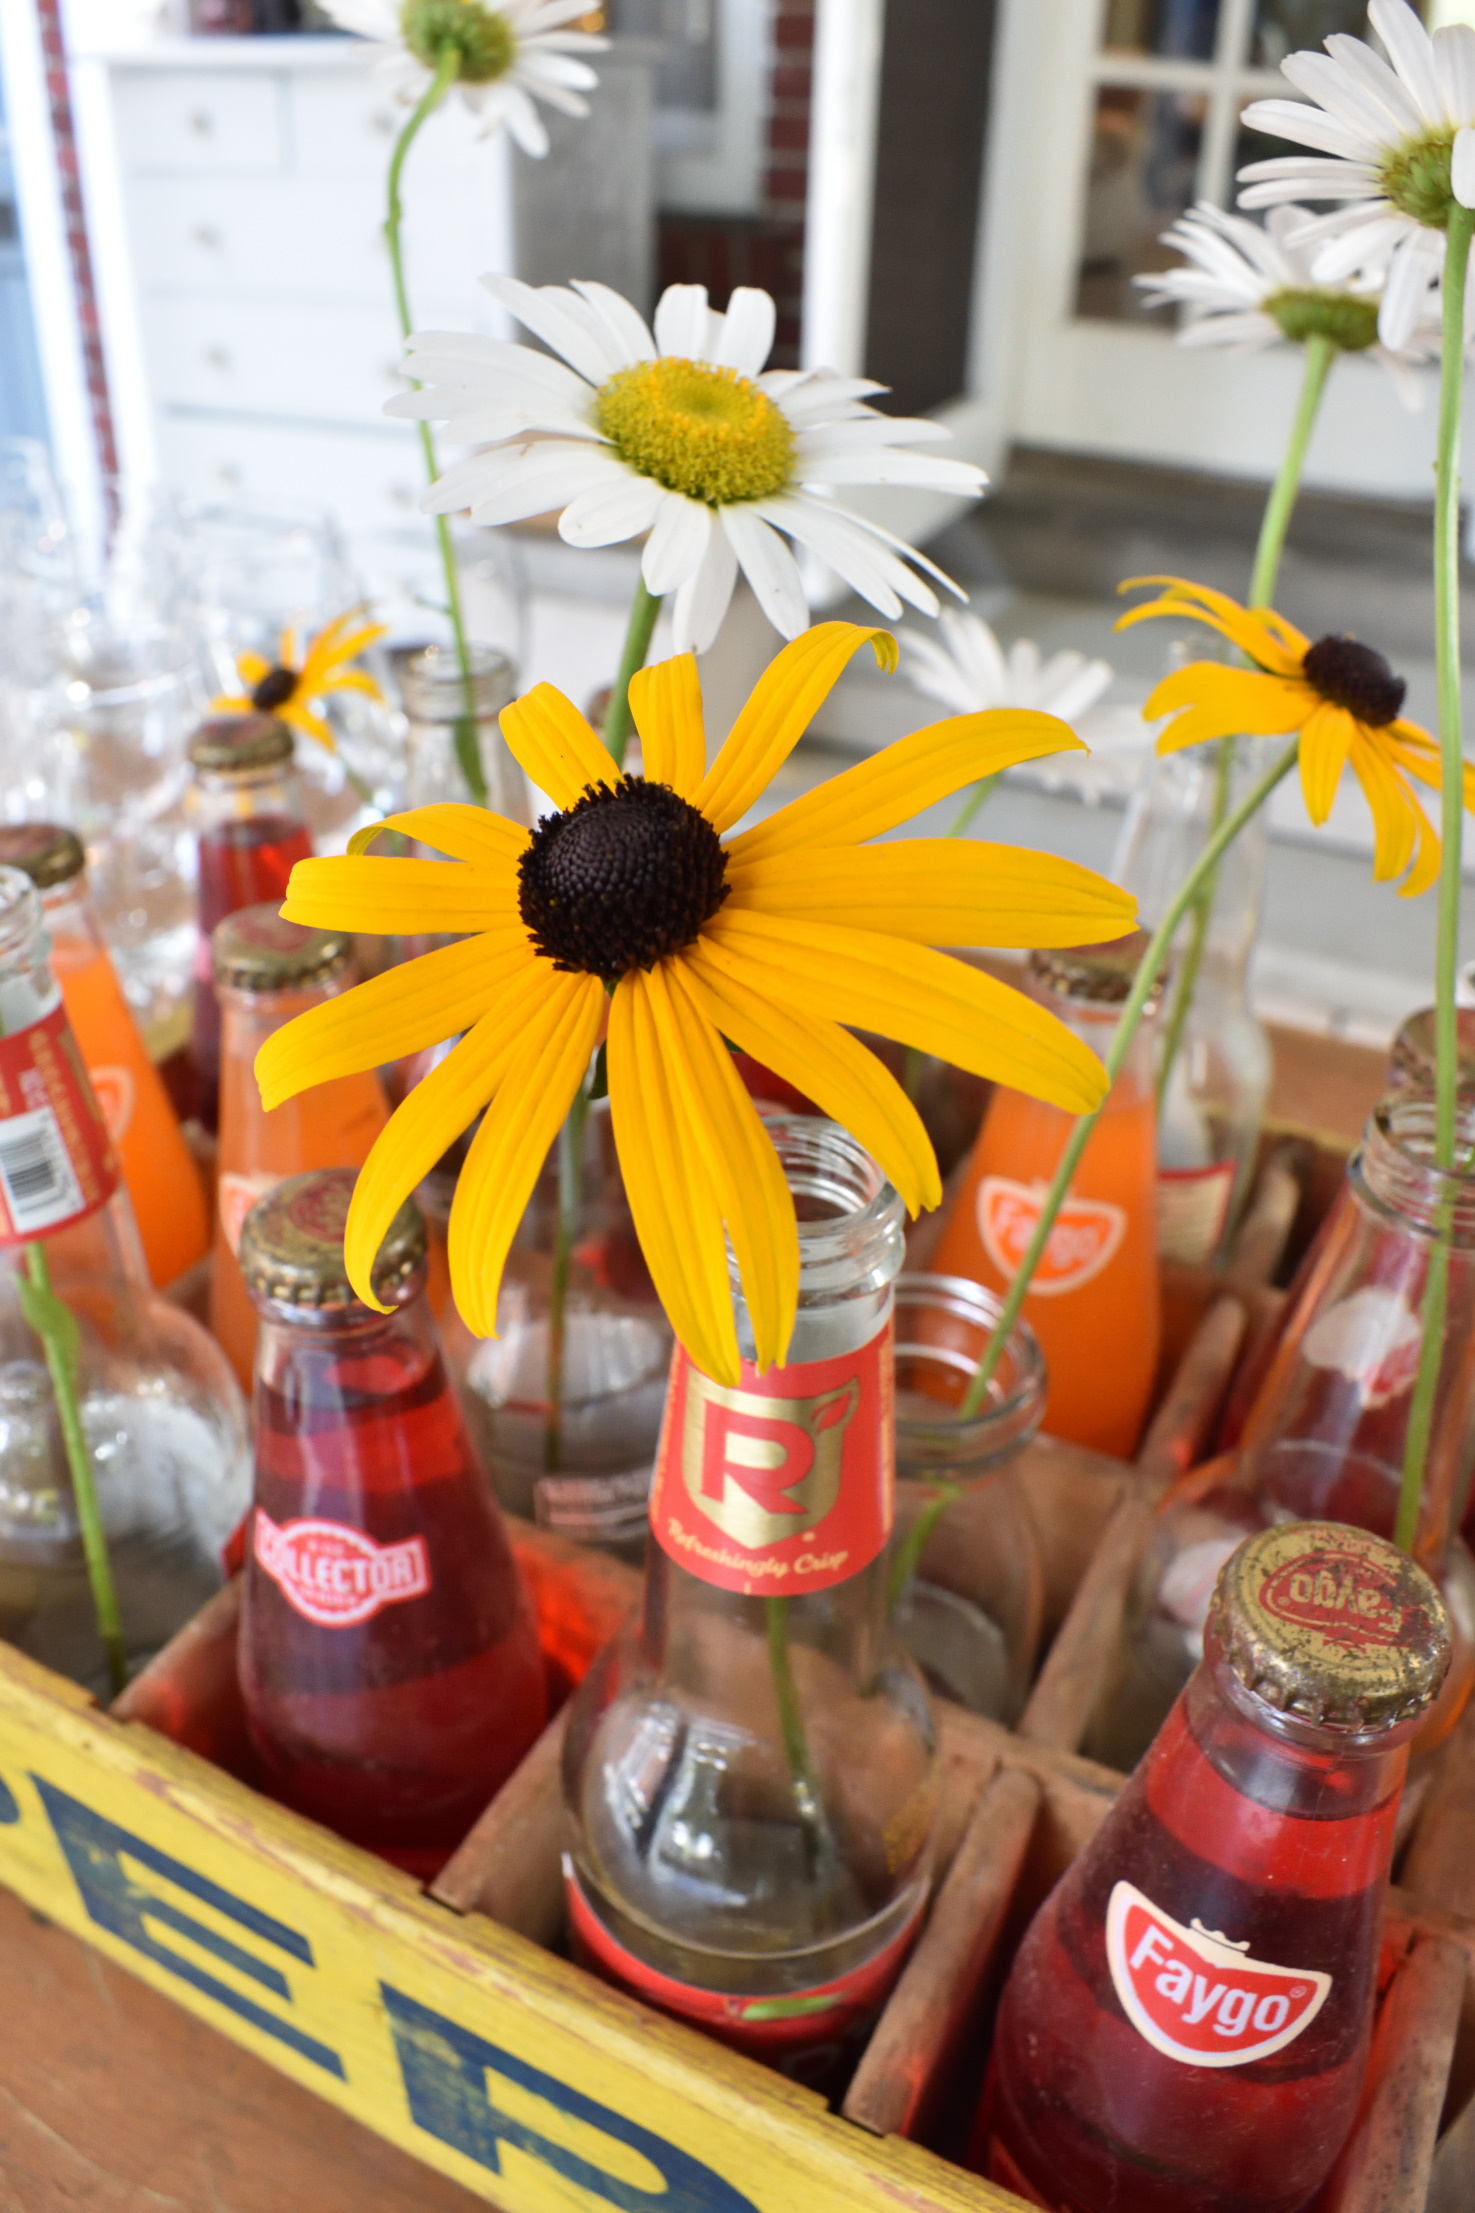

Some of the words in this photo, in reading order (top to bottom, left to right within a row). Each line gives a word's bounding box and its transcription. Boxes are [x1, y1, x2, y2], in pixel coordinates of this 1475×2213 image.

[667, 1516, 789, 1579] Refreshingly
[793, 1551, 849, 1575] Crisp
[1129, 1922, 1291, 2037] Faygo
